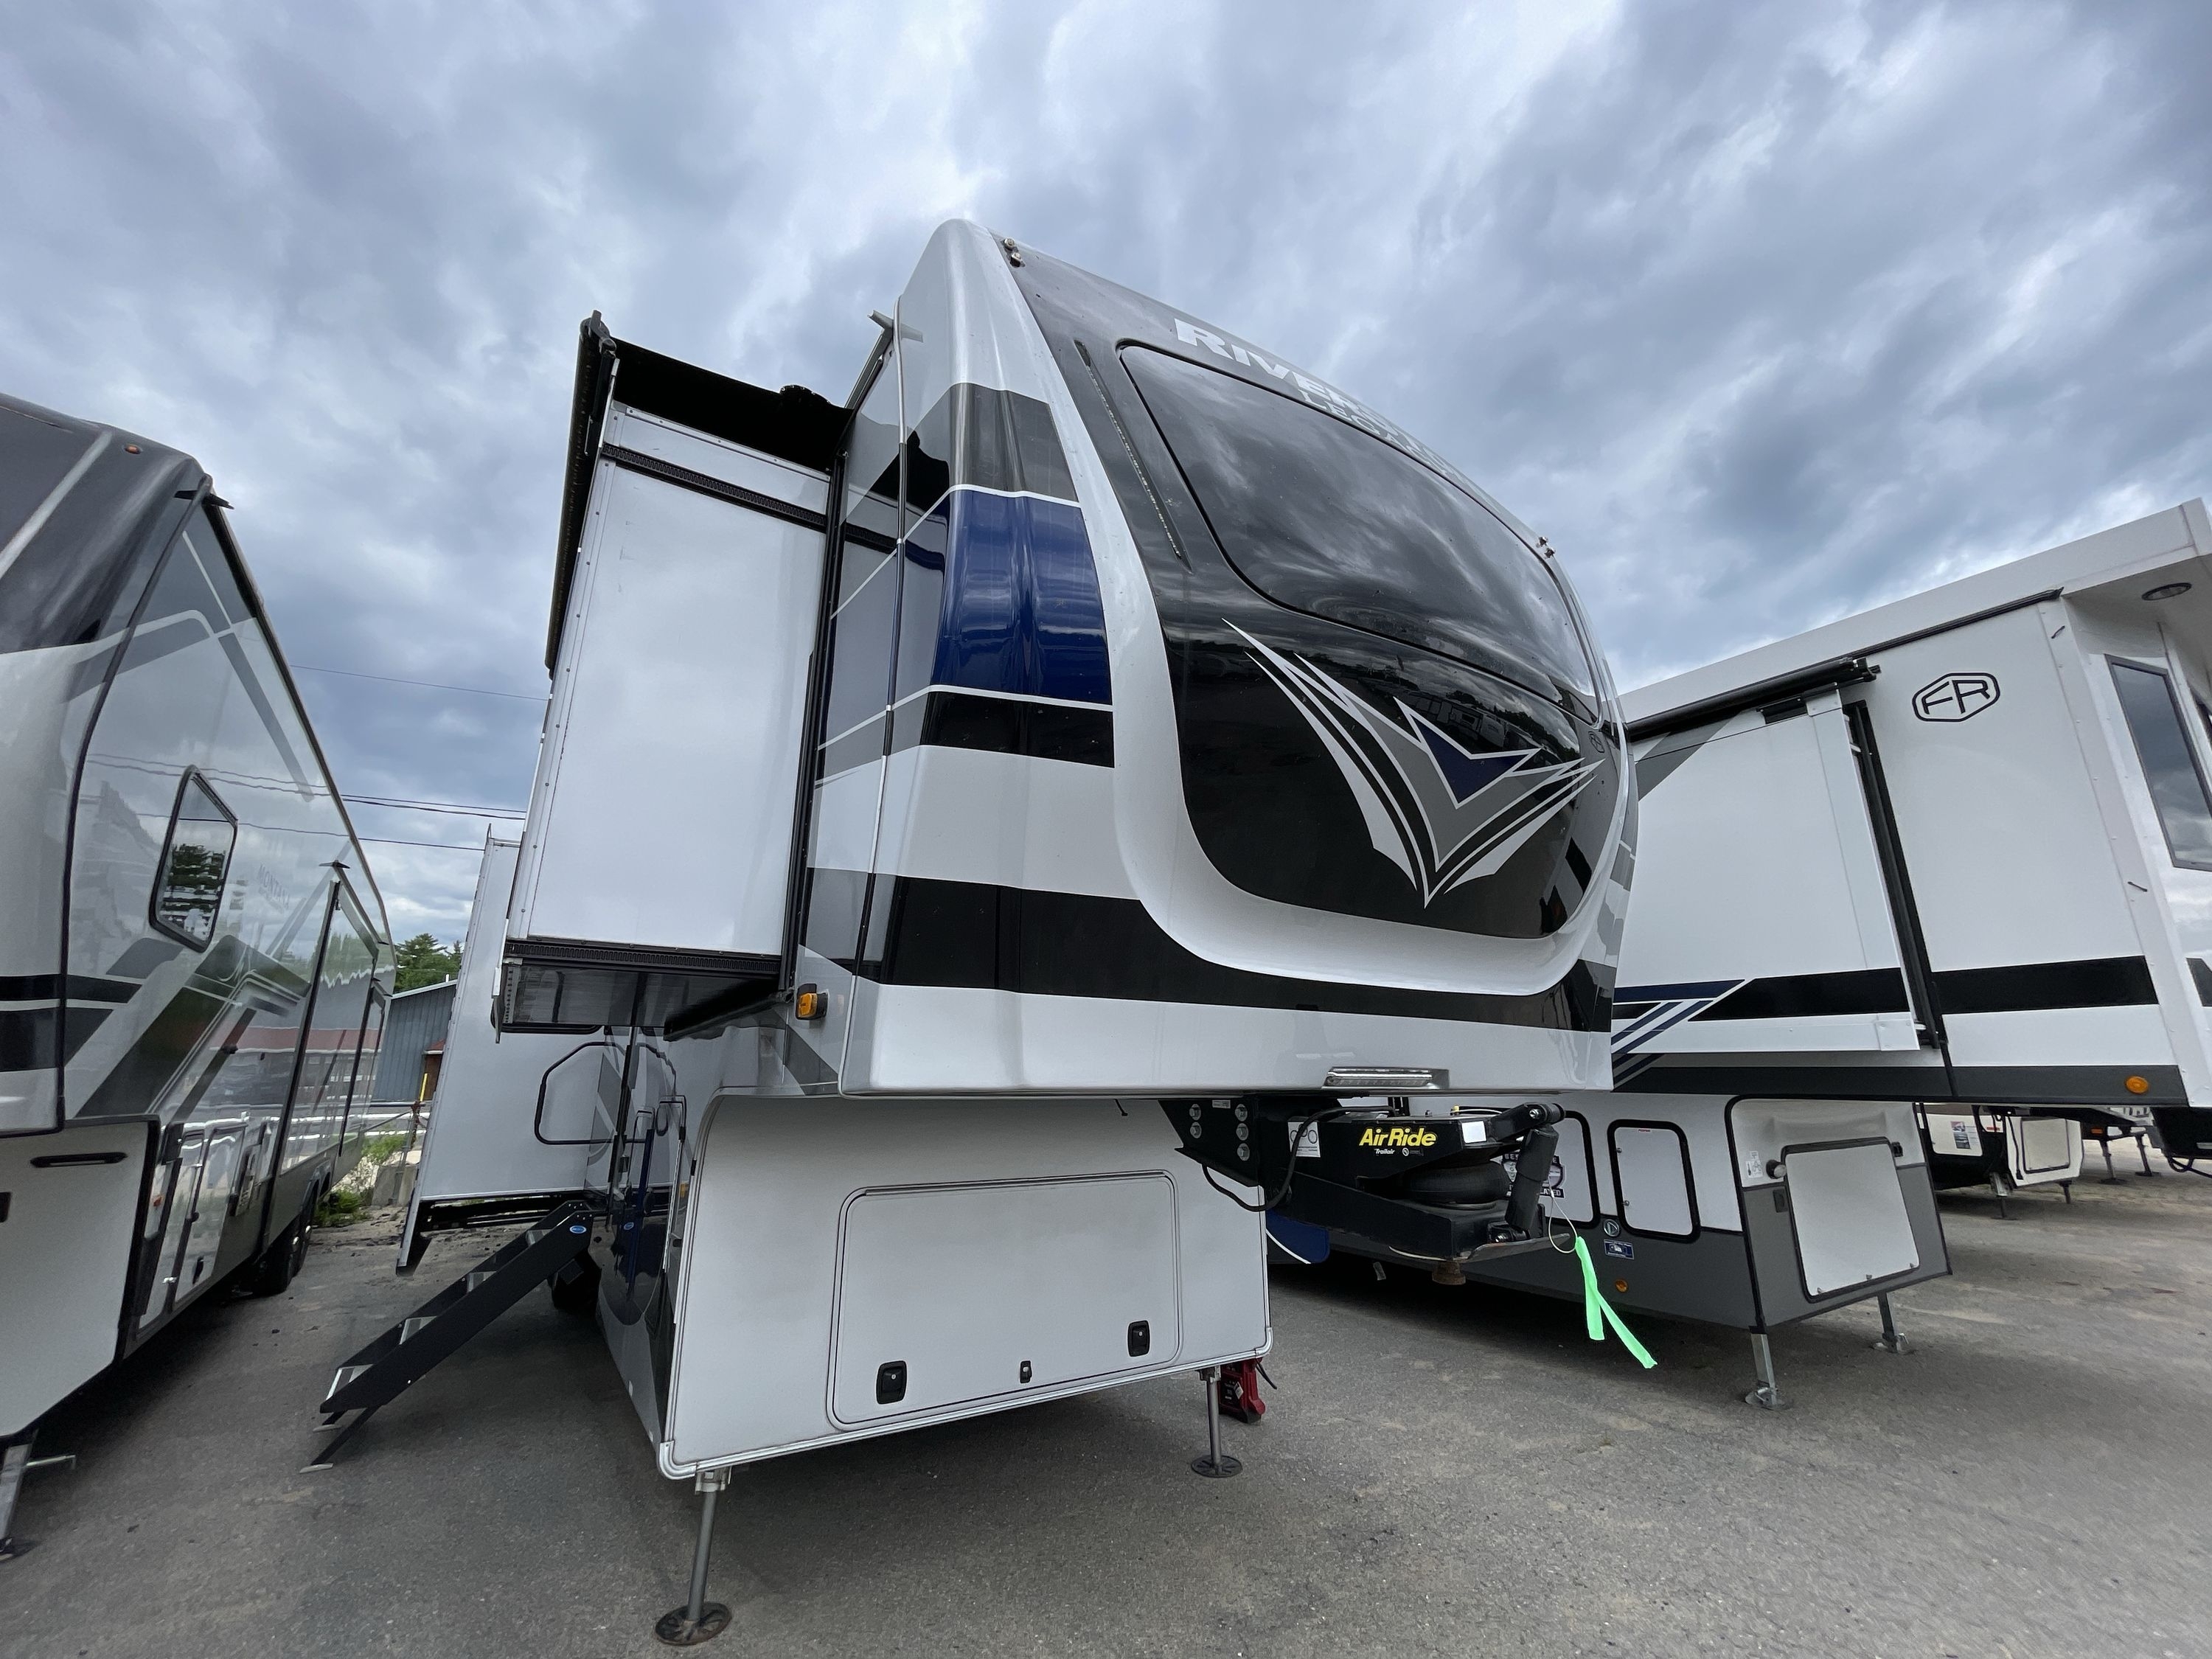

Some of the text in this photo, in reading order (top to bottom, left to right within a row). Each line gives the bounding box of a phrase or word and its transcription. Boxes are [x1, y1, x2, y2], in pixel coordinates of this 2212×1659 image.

[1174, 318, 1501, 514] RIVERSTONE
[1298, 388, 1453, 476] LEGACY
[1921, 679, 1991, 715] FR
